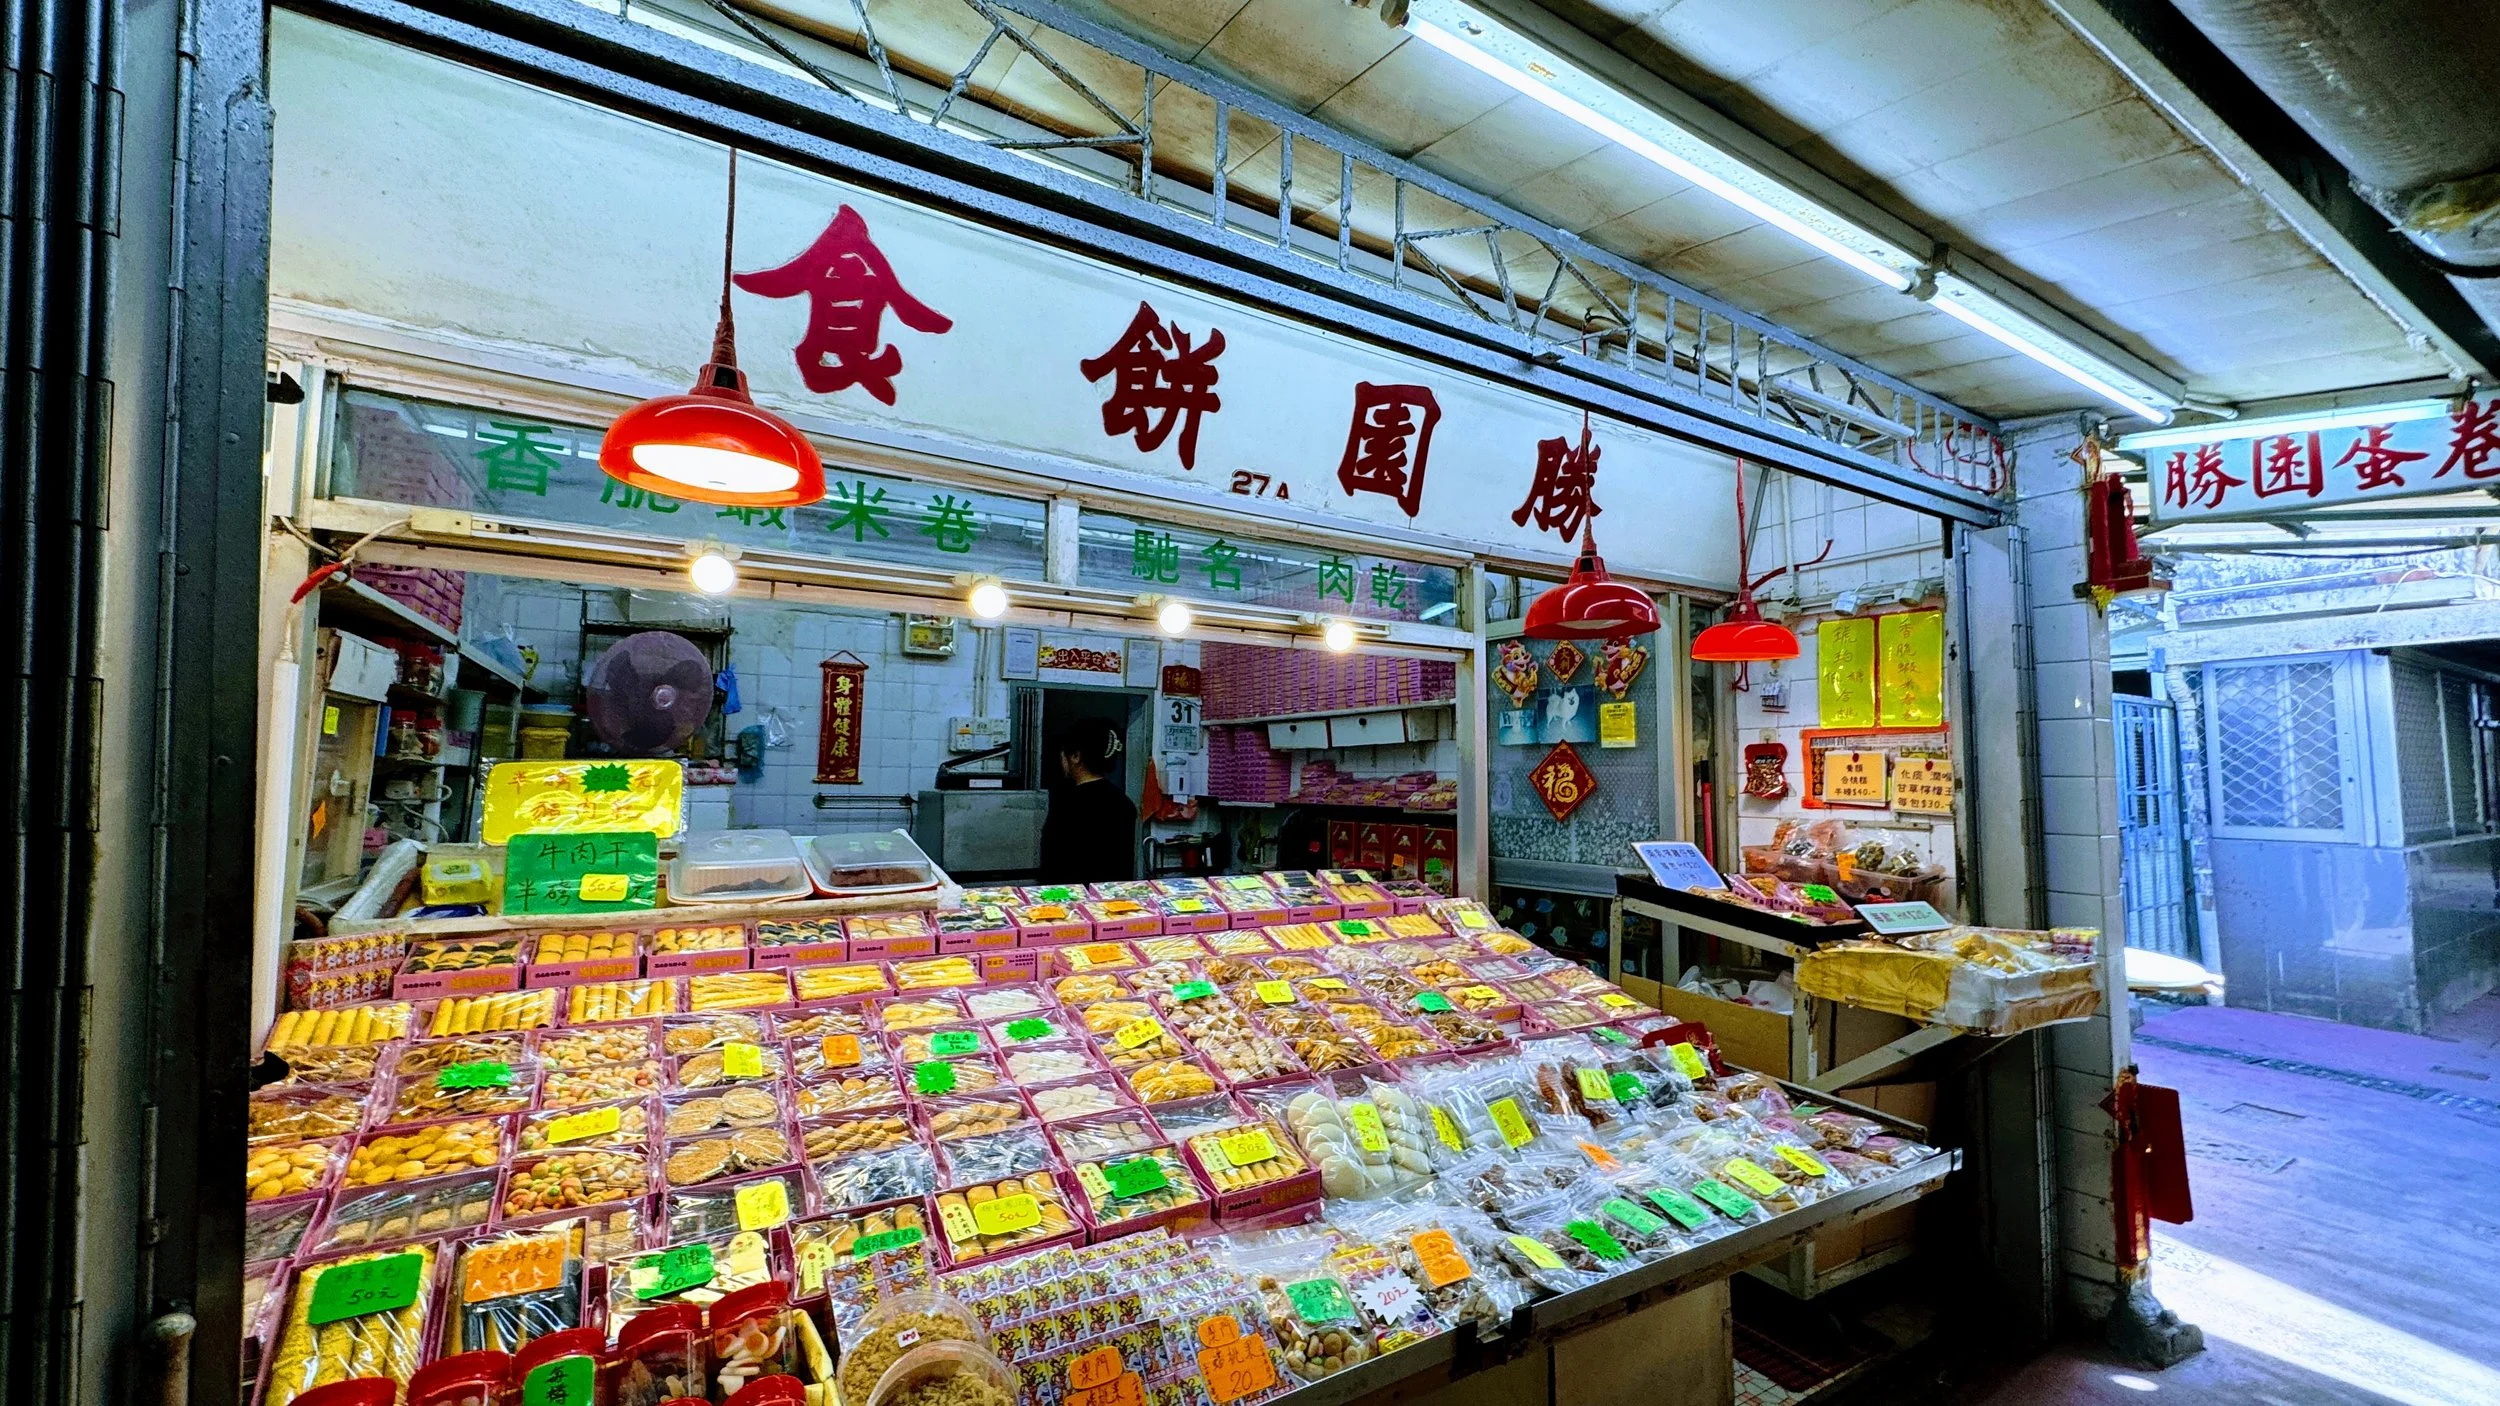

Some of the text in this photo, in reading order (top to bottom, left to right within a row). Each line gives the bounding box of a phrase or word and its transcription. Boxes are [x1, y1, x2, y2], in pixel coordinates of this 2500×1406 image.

[1057, 649, 1103, 666] 出入平安
[831, 675, 854, 758] 身體健康
[1171, 701, 1193, 724] 31
[1541, 762, 1579, 804] 福
[661, 1274, 687, 1292] 60
[346, 1286, 401, 1305] 50元
[1229, 1369, 1254, 1396] 20
